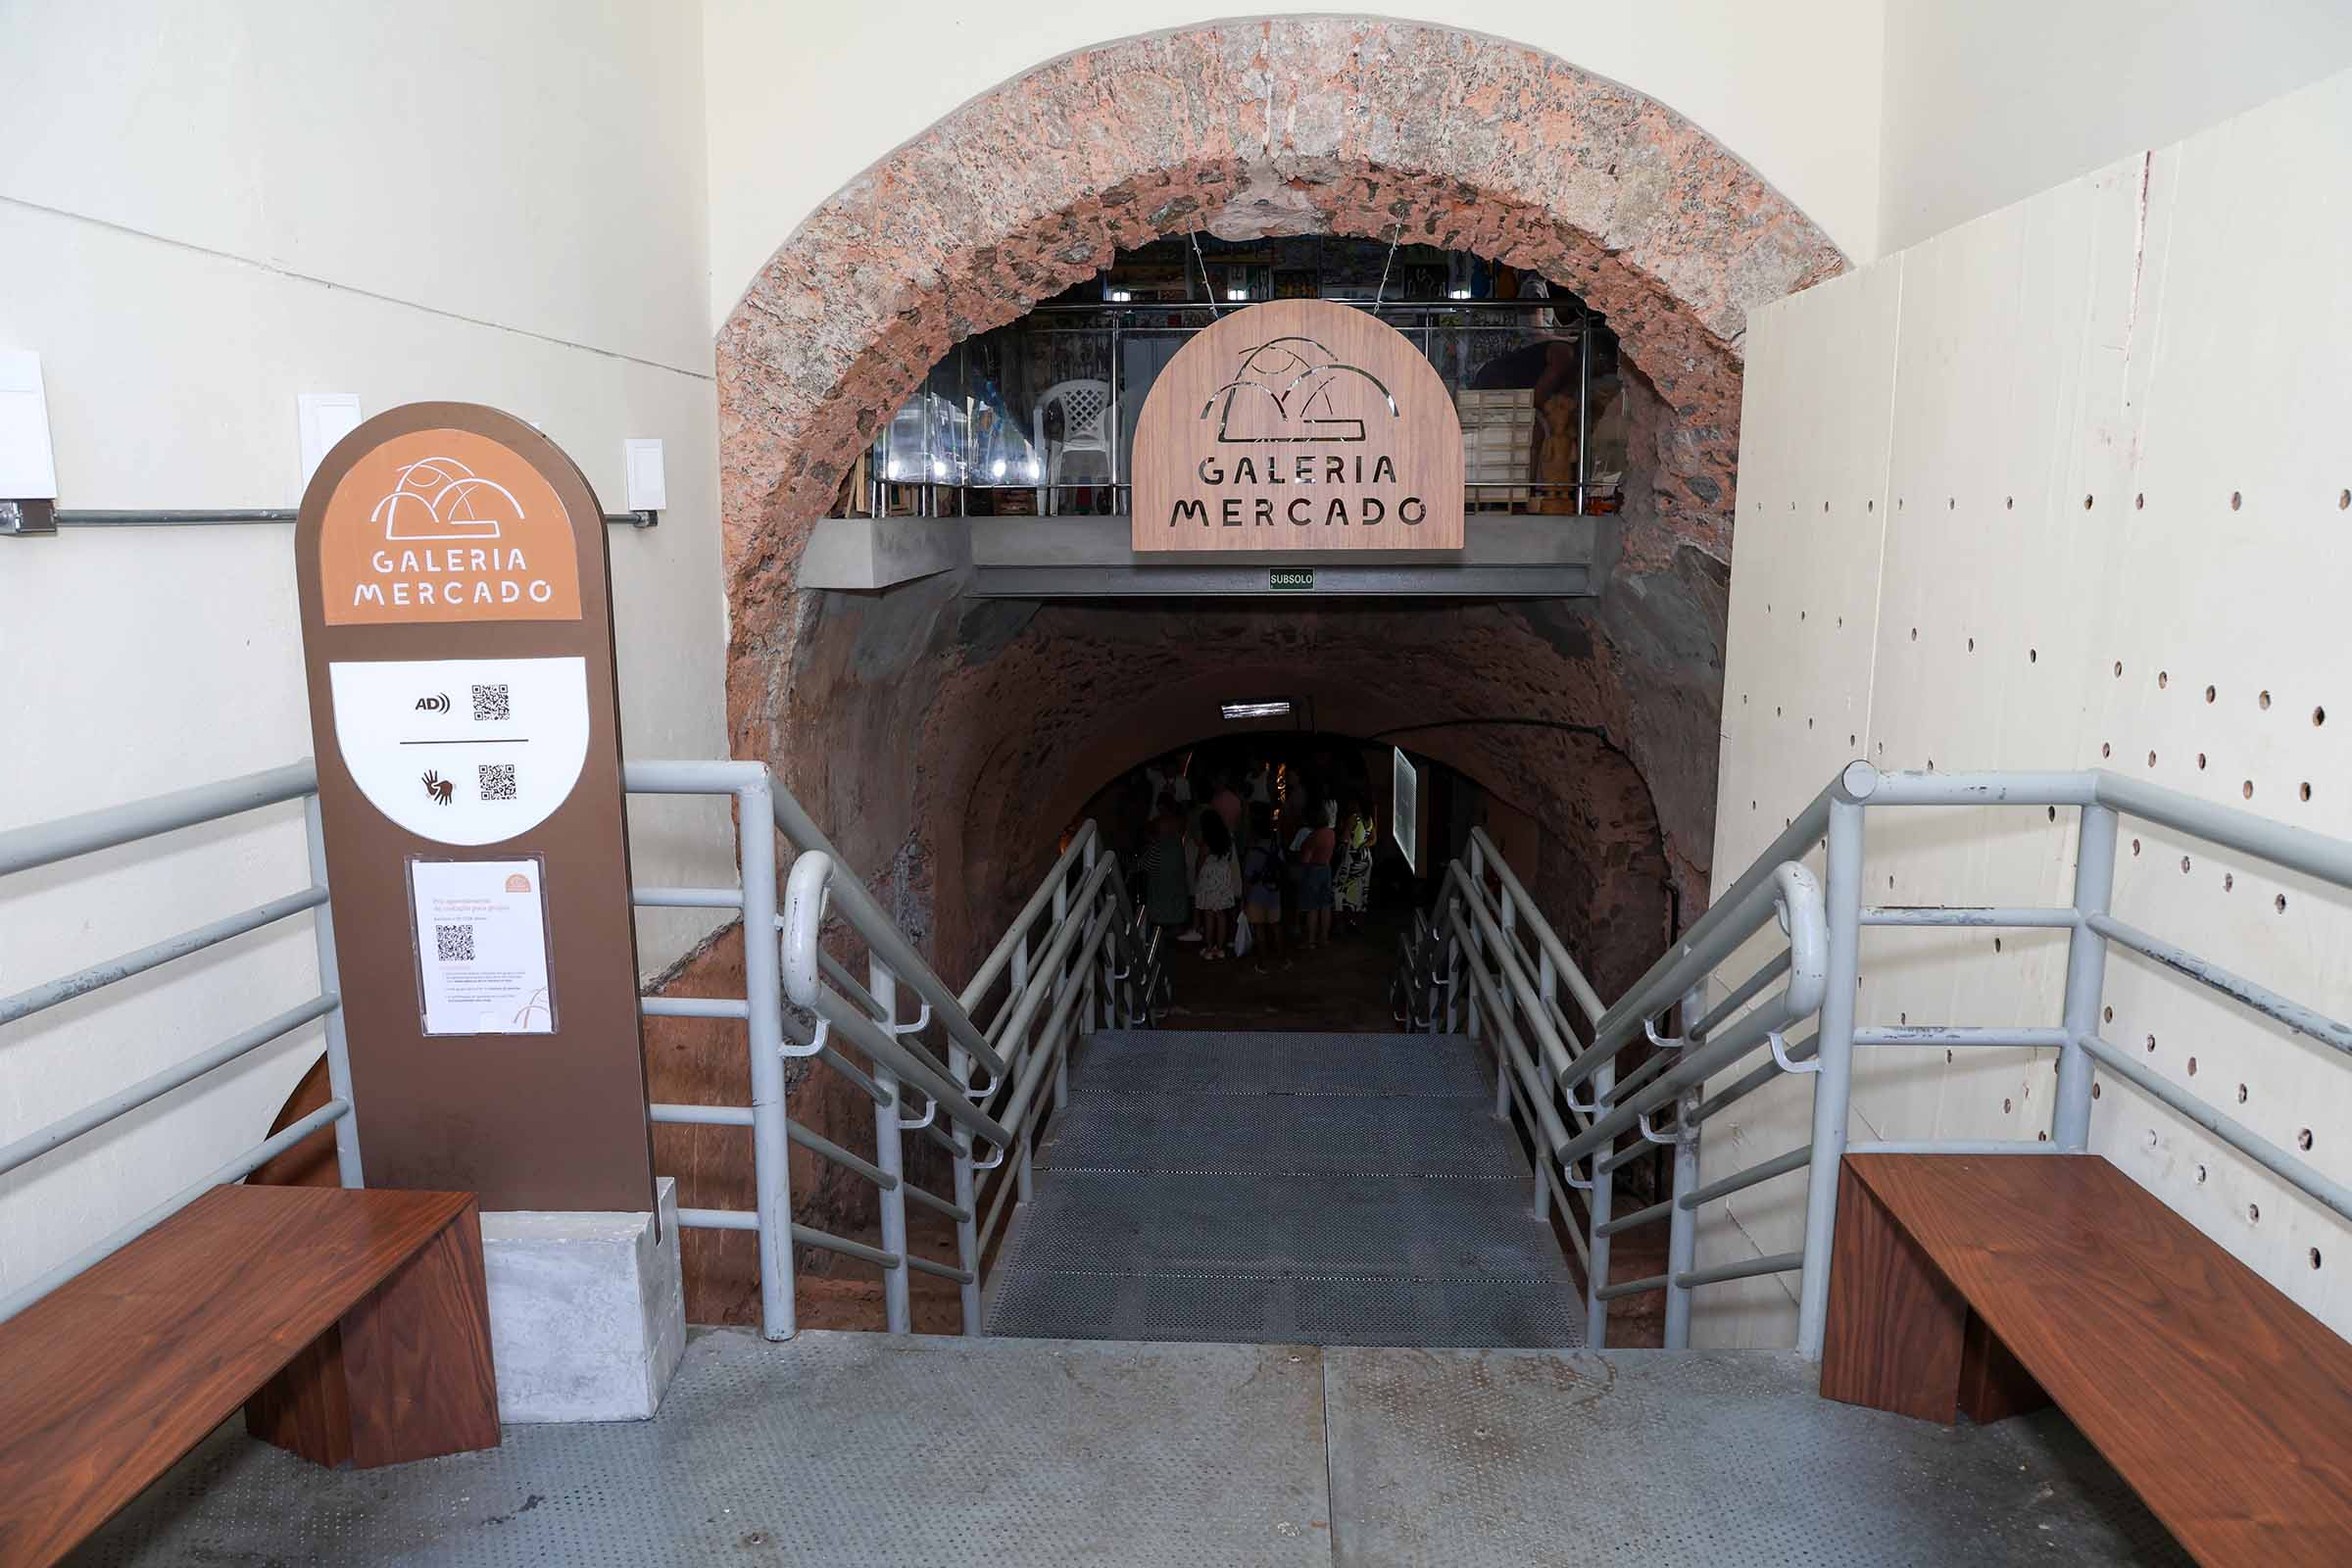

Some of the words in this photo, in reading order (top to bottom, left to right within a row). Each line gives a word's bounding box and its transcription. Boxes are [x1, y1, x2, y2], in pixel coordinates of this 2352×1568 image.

[1199, 456, 1396, 485] GALERIA
[1169, 497, 1427, 527] MERCADO
[371, 548, 527, 573] GALERIA
[1270, 573, 1312, 584] SUBSOLO
[353, 579, 552, 607] MERCADO
